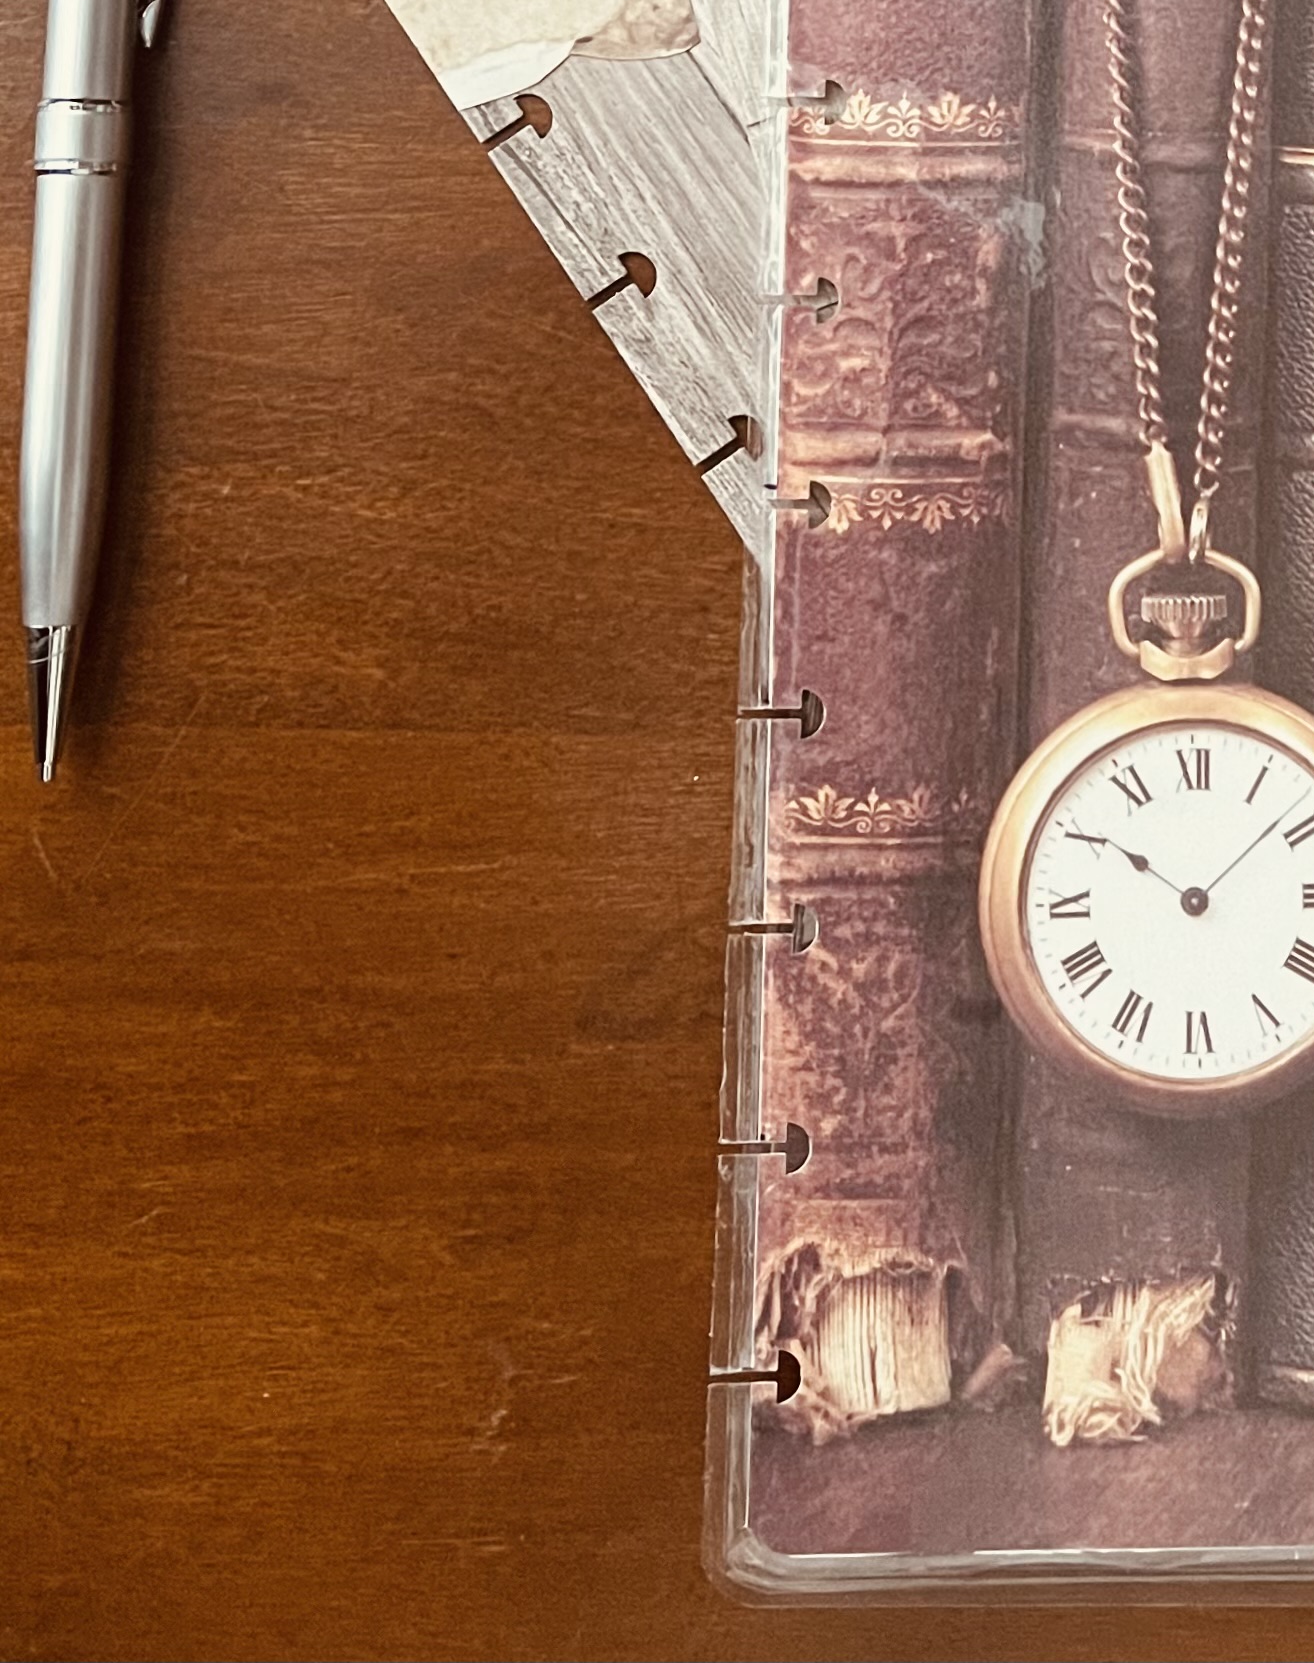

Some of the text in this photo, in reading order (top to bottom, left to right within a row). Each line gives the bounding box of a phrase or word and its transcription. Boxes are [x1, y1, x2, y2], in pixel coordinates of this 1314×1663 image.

[1108, 764, 1154, 816] XI
[1176, 748, 1211, 793] XII
[1064, 818, 1107, 860] X
[1048, 889, 1091, 919] IX
[1061, 940, 1112, 1000] VIII
[1111, 989, 1154, 1044] VII
[1182, 1011, 1215, 1054] VI
[1251, 993, 1284, 1037] V
